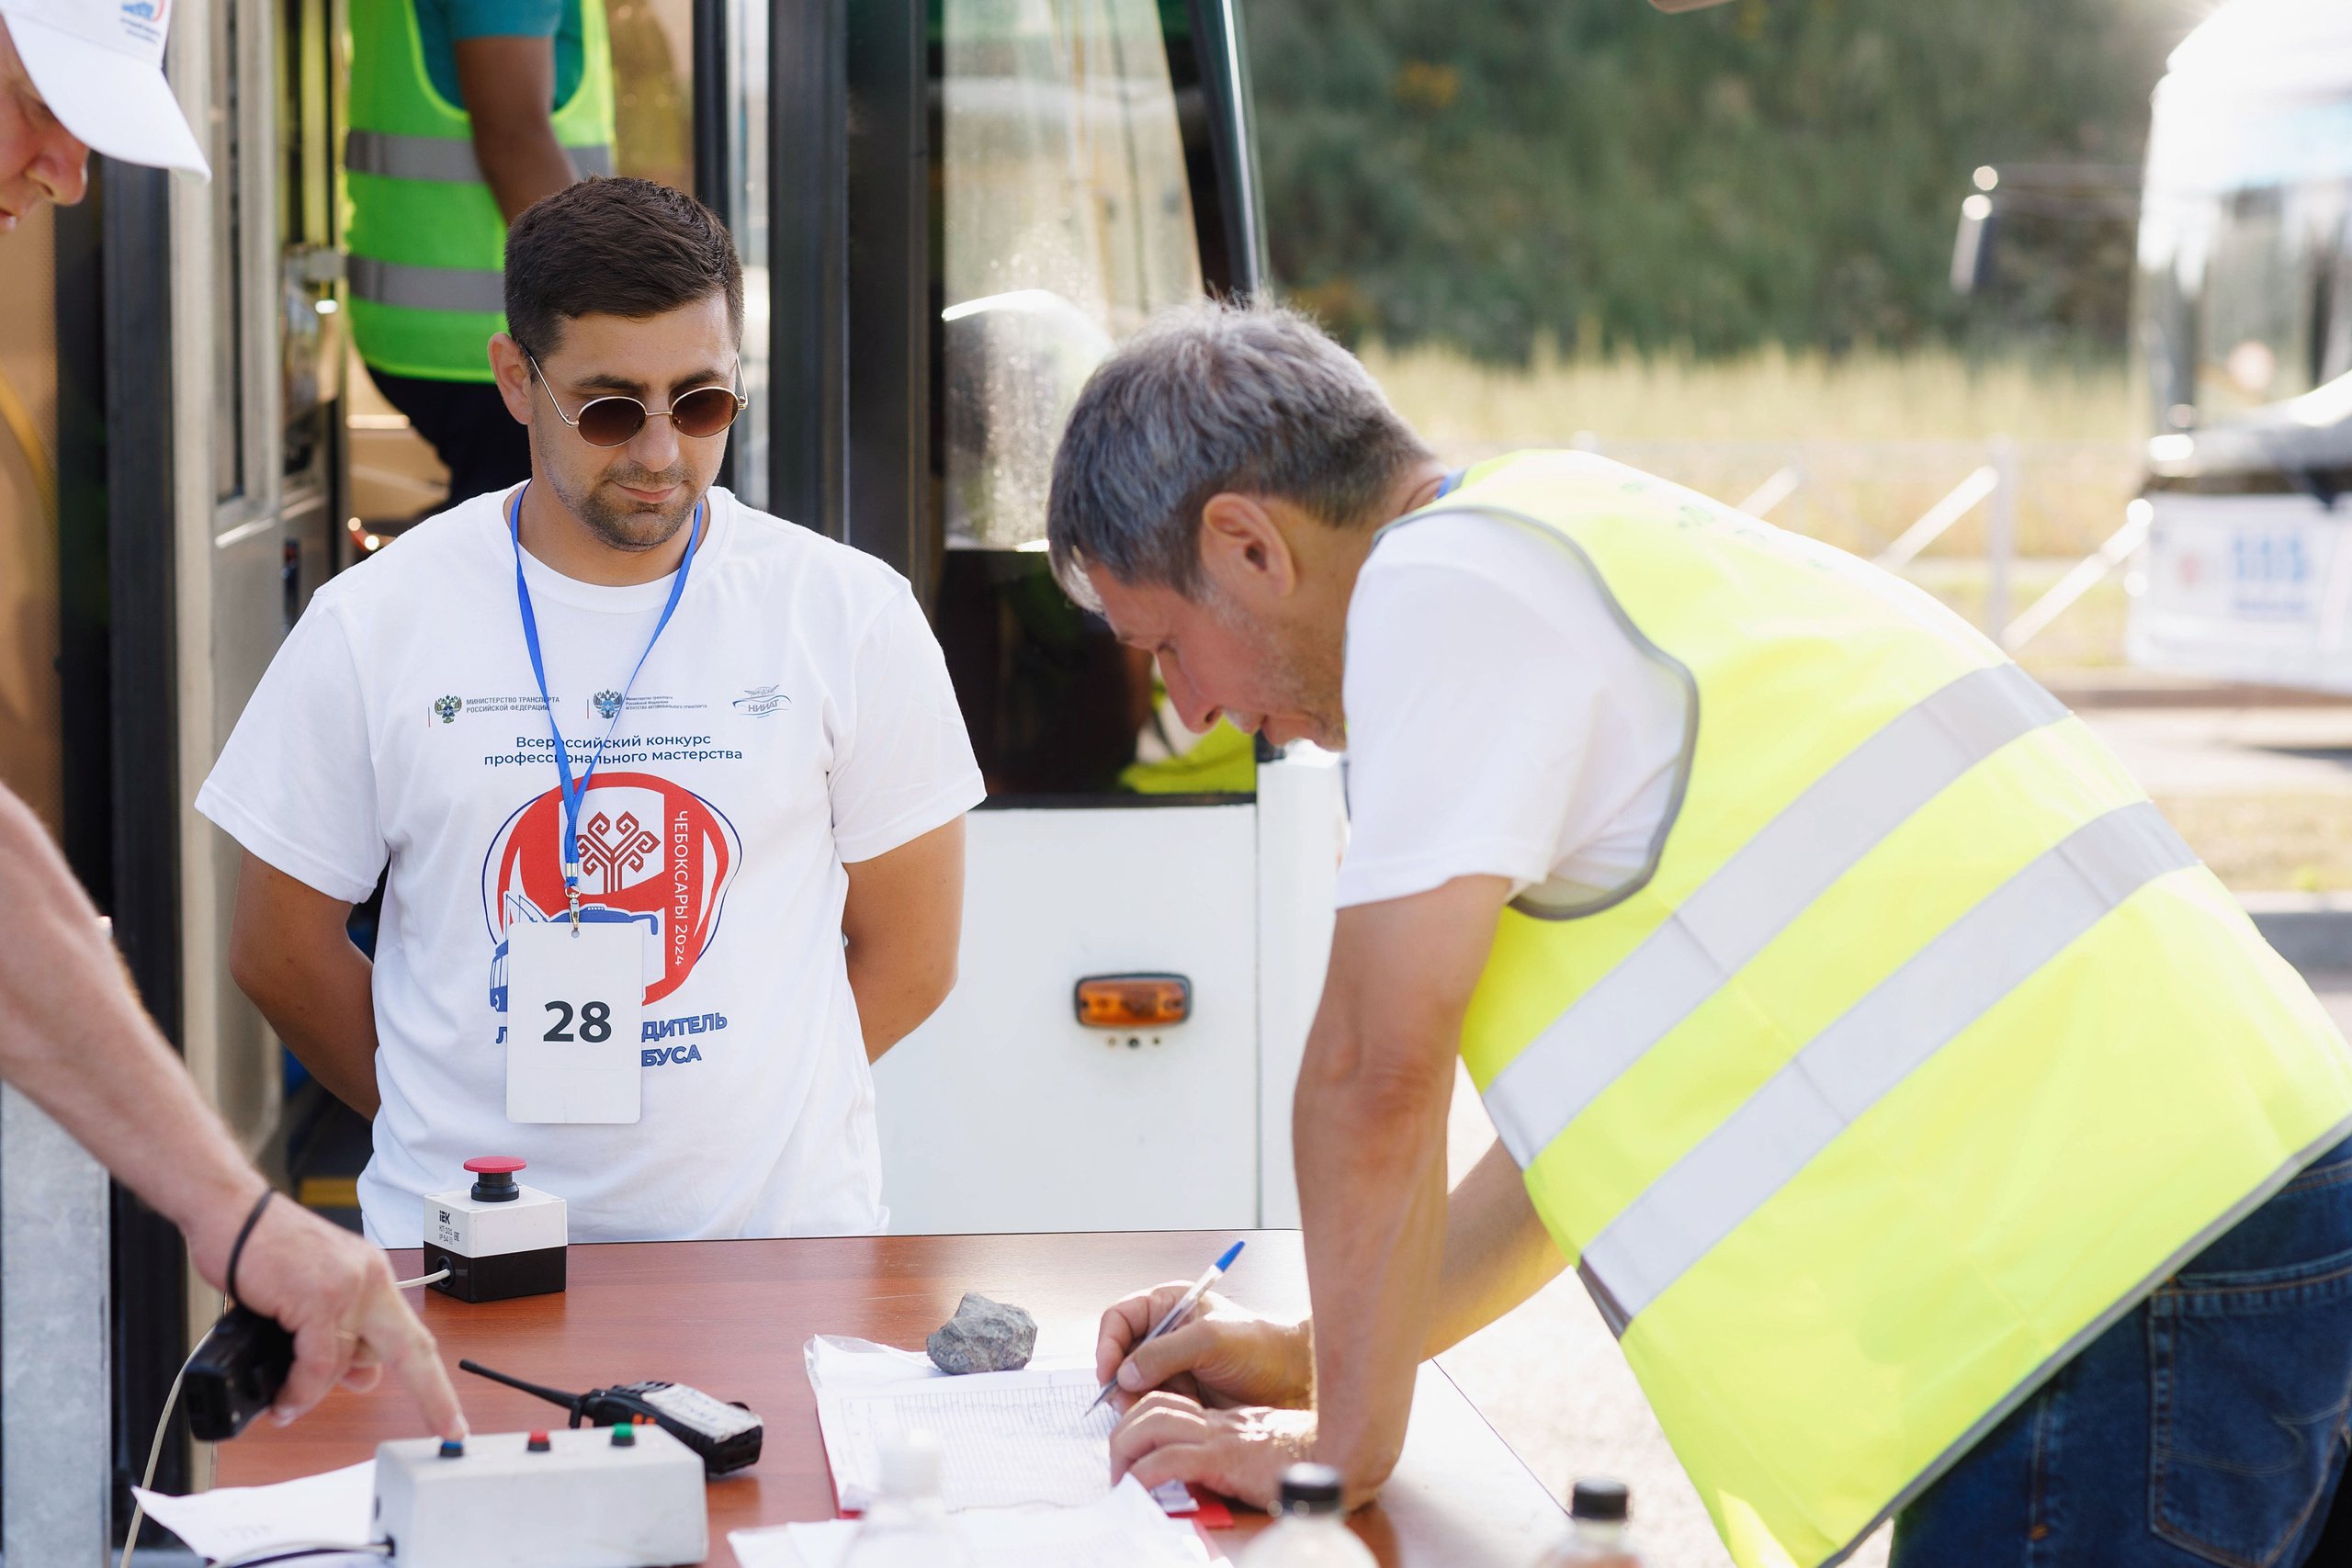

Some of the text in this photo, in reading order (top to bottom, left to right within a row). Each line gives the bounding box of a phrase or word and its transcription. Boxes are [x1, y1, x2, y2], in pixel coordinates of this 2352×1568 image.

[466, 697, 517, 705] МИНИСТЕРСТВО
[466, 704, 549, 713] РОССИЙСКОЙ ФЕДЕРАЦИИ
[748, 698, 779, 713] НИИАТ
[516, 735, 711, 750] Всерссийский конкурс
[651, 749, 743, 761] мастерства
[673, 810, 688, 966] ЧЕБОКСАРЫ 2024
[543, 1000, 612, 1043] 28
[641, 1012, 728, 1043] ДИТЕЛЬ
[641, 1044, 702, 1067] БУСА
